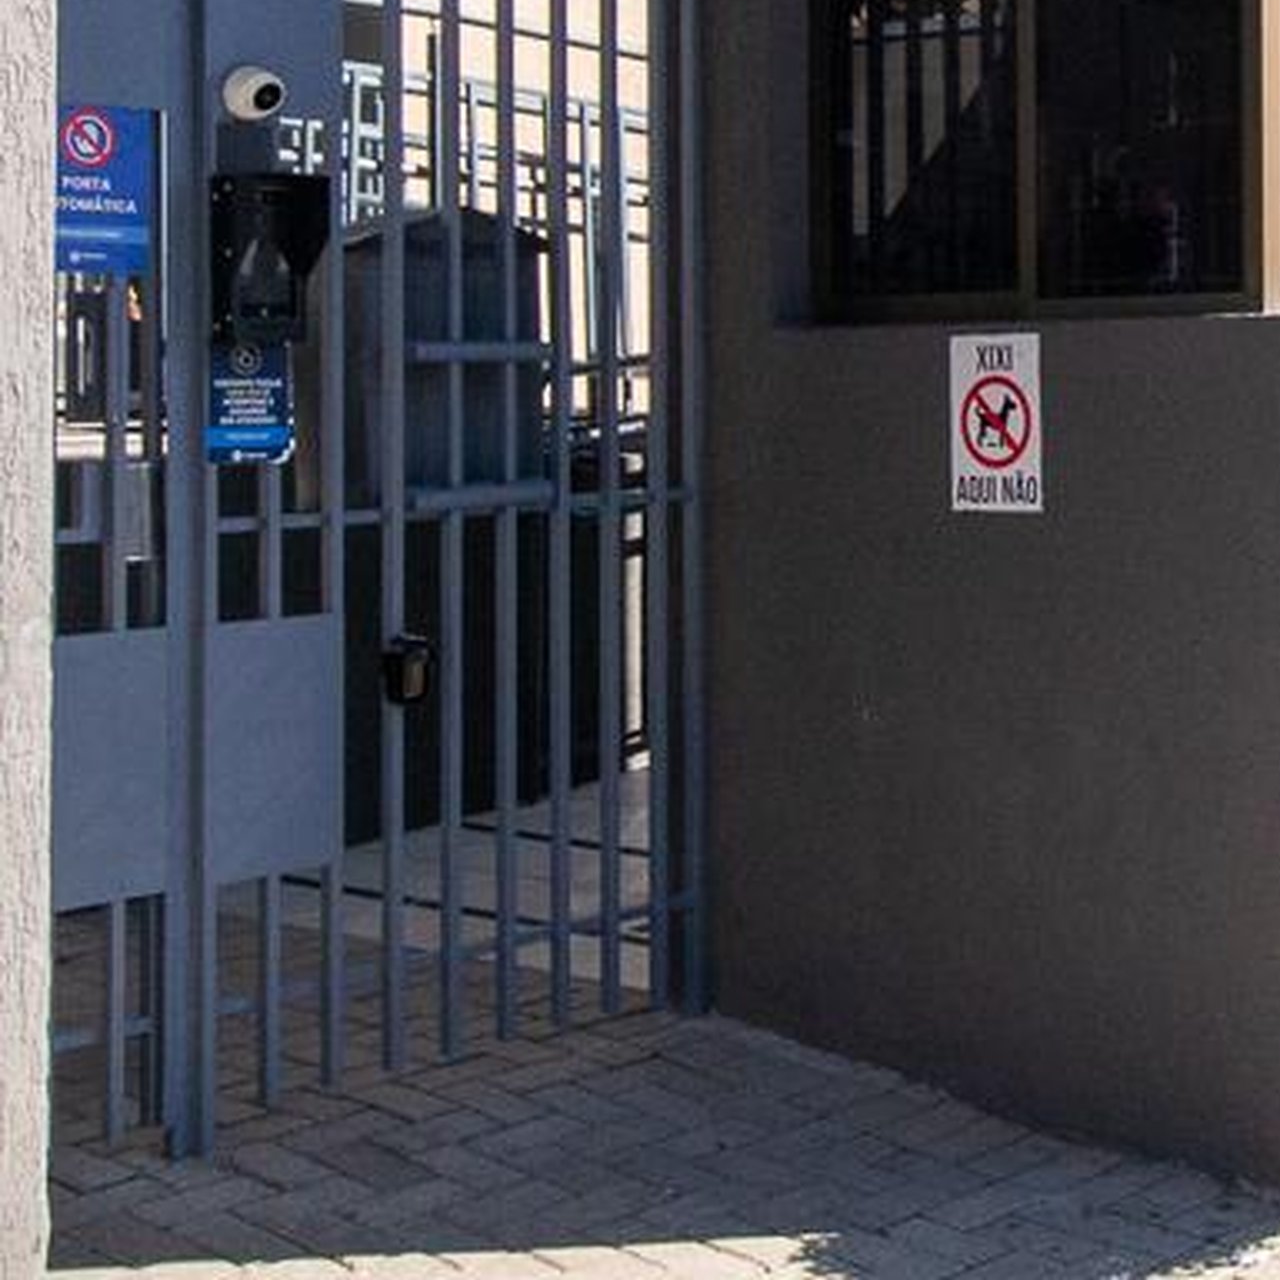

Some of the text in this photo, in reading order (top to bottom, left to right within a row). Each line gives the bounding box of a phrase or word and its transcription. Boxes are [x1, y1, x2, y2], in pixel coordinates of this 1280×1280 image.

[61, 175, 111, 191] PORTA
[976, 345, 1015, 373] XIXI
[956, 470, 1037, 505] AQUI NÃO
